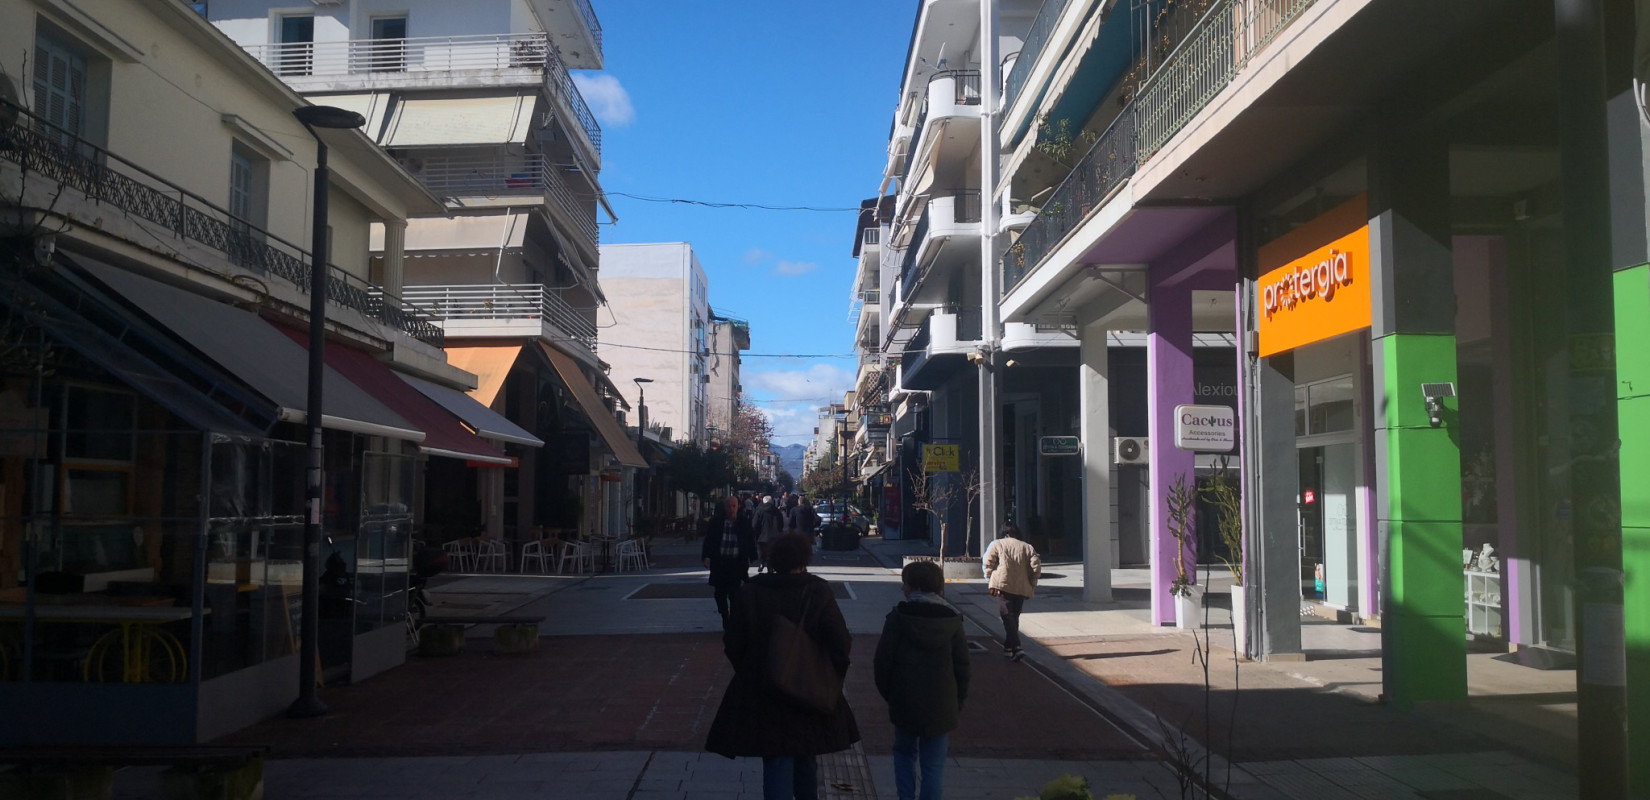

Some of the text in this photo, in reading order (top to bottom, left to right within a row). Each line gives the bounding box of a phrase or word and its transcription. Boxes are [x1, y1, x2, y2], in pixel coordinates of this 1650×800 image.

[1263, 248, 1347, 318] protergia
[1181, 413, 1233, 427] Cactus
[1189, 429, 1226, 437] Accessories
